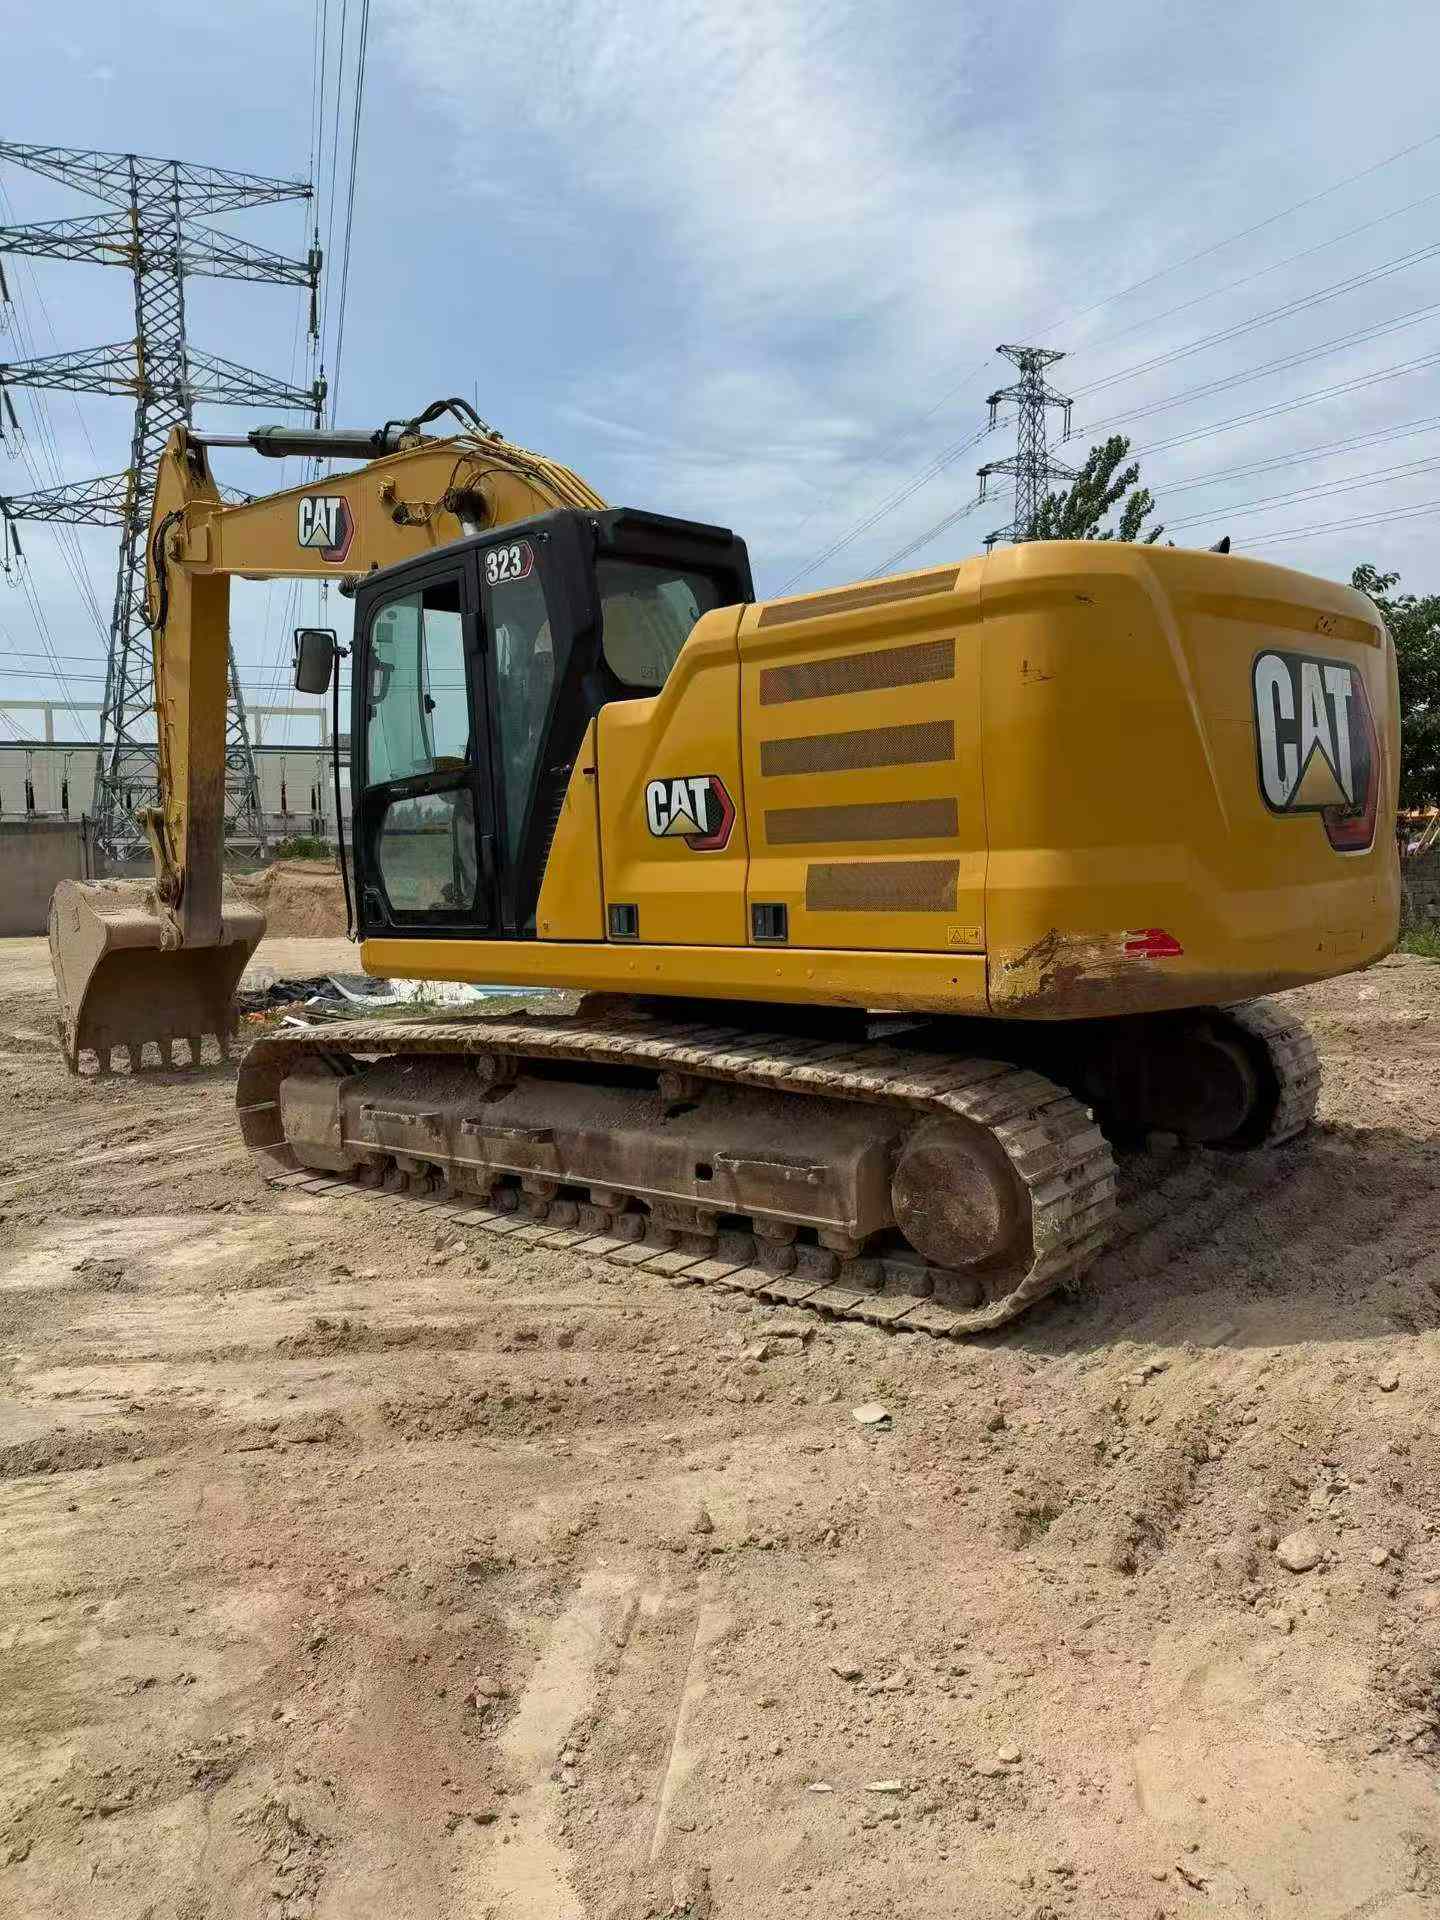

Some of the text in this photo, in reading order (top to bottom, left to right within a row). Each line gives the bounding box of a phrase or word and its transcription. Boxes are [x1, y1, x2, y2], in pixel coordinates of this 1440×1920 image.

[299, 497, 341, 546] CAT
[487, 545, 521, 582] 323
[1255, 654, 1354, 806] CAT
[646, 777, 710, 835] CAT
